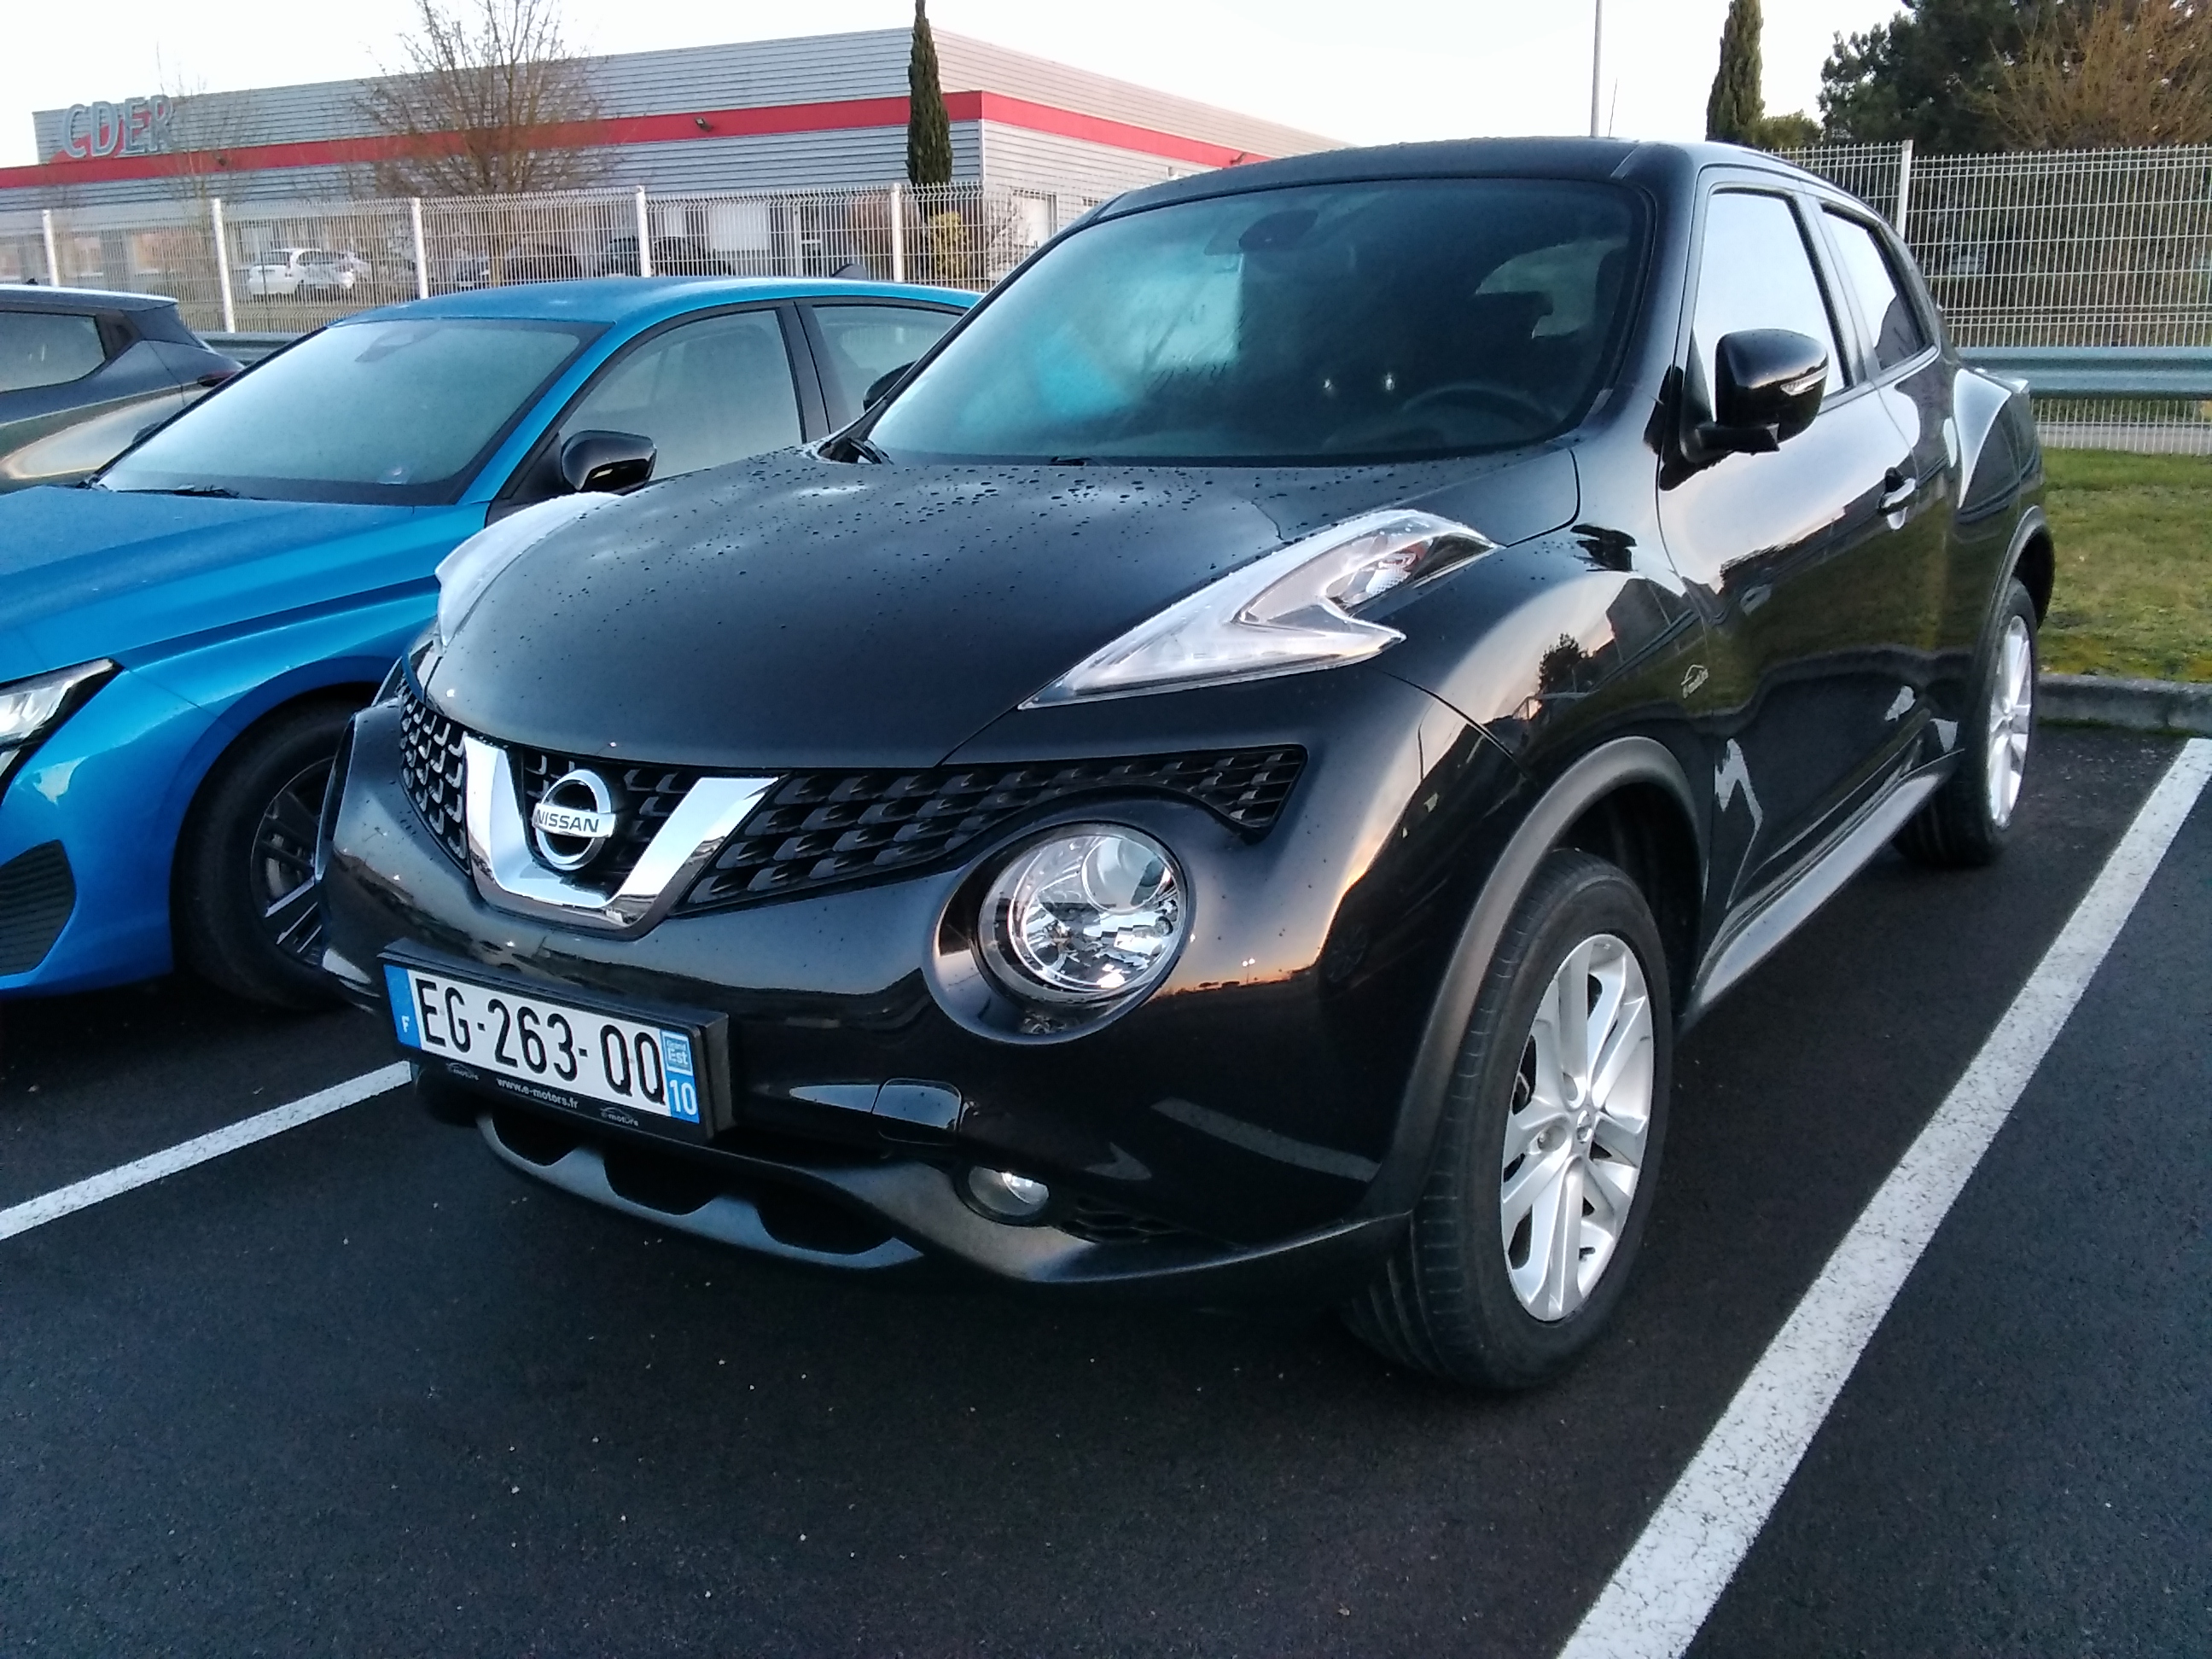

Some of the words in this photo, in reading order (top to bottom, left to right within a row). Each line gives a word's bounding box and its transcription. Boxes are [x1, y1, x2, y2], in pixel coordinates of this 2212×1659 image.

[63, 95, 173, 158] CDER
[536, 808, 599, 833] NISSAN
[401, 1016, 410, 1033] F
[416, 978, 666, 1106] EG-263-QQ
[667, 1047, 689, 1066] Est
[497, 1078, 579, 1109] www.e-motors.fr
[669, 1080, 697, 1115] 10
